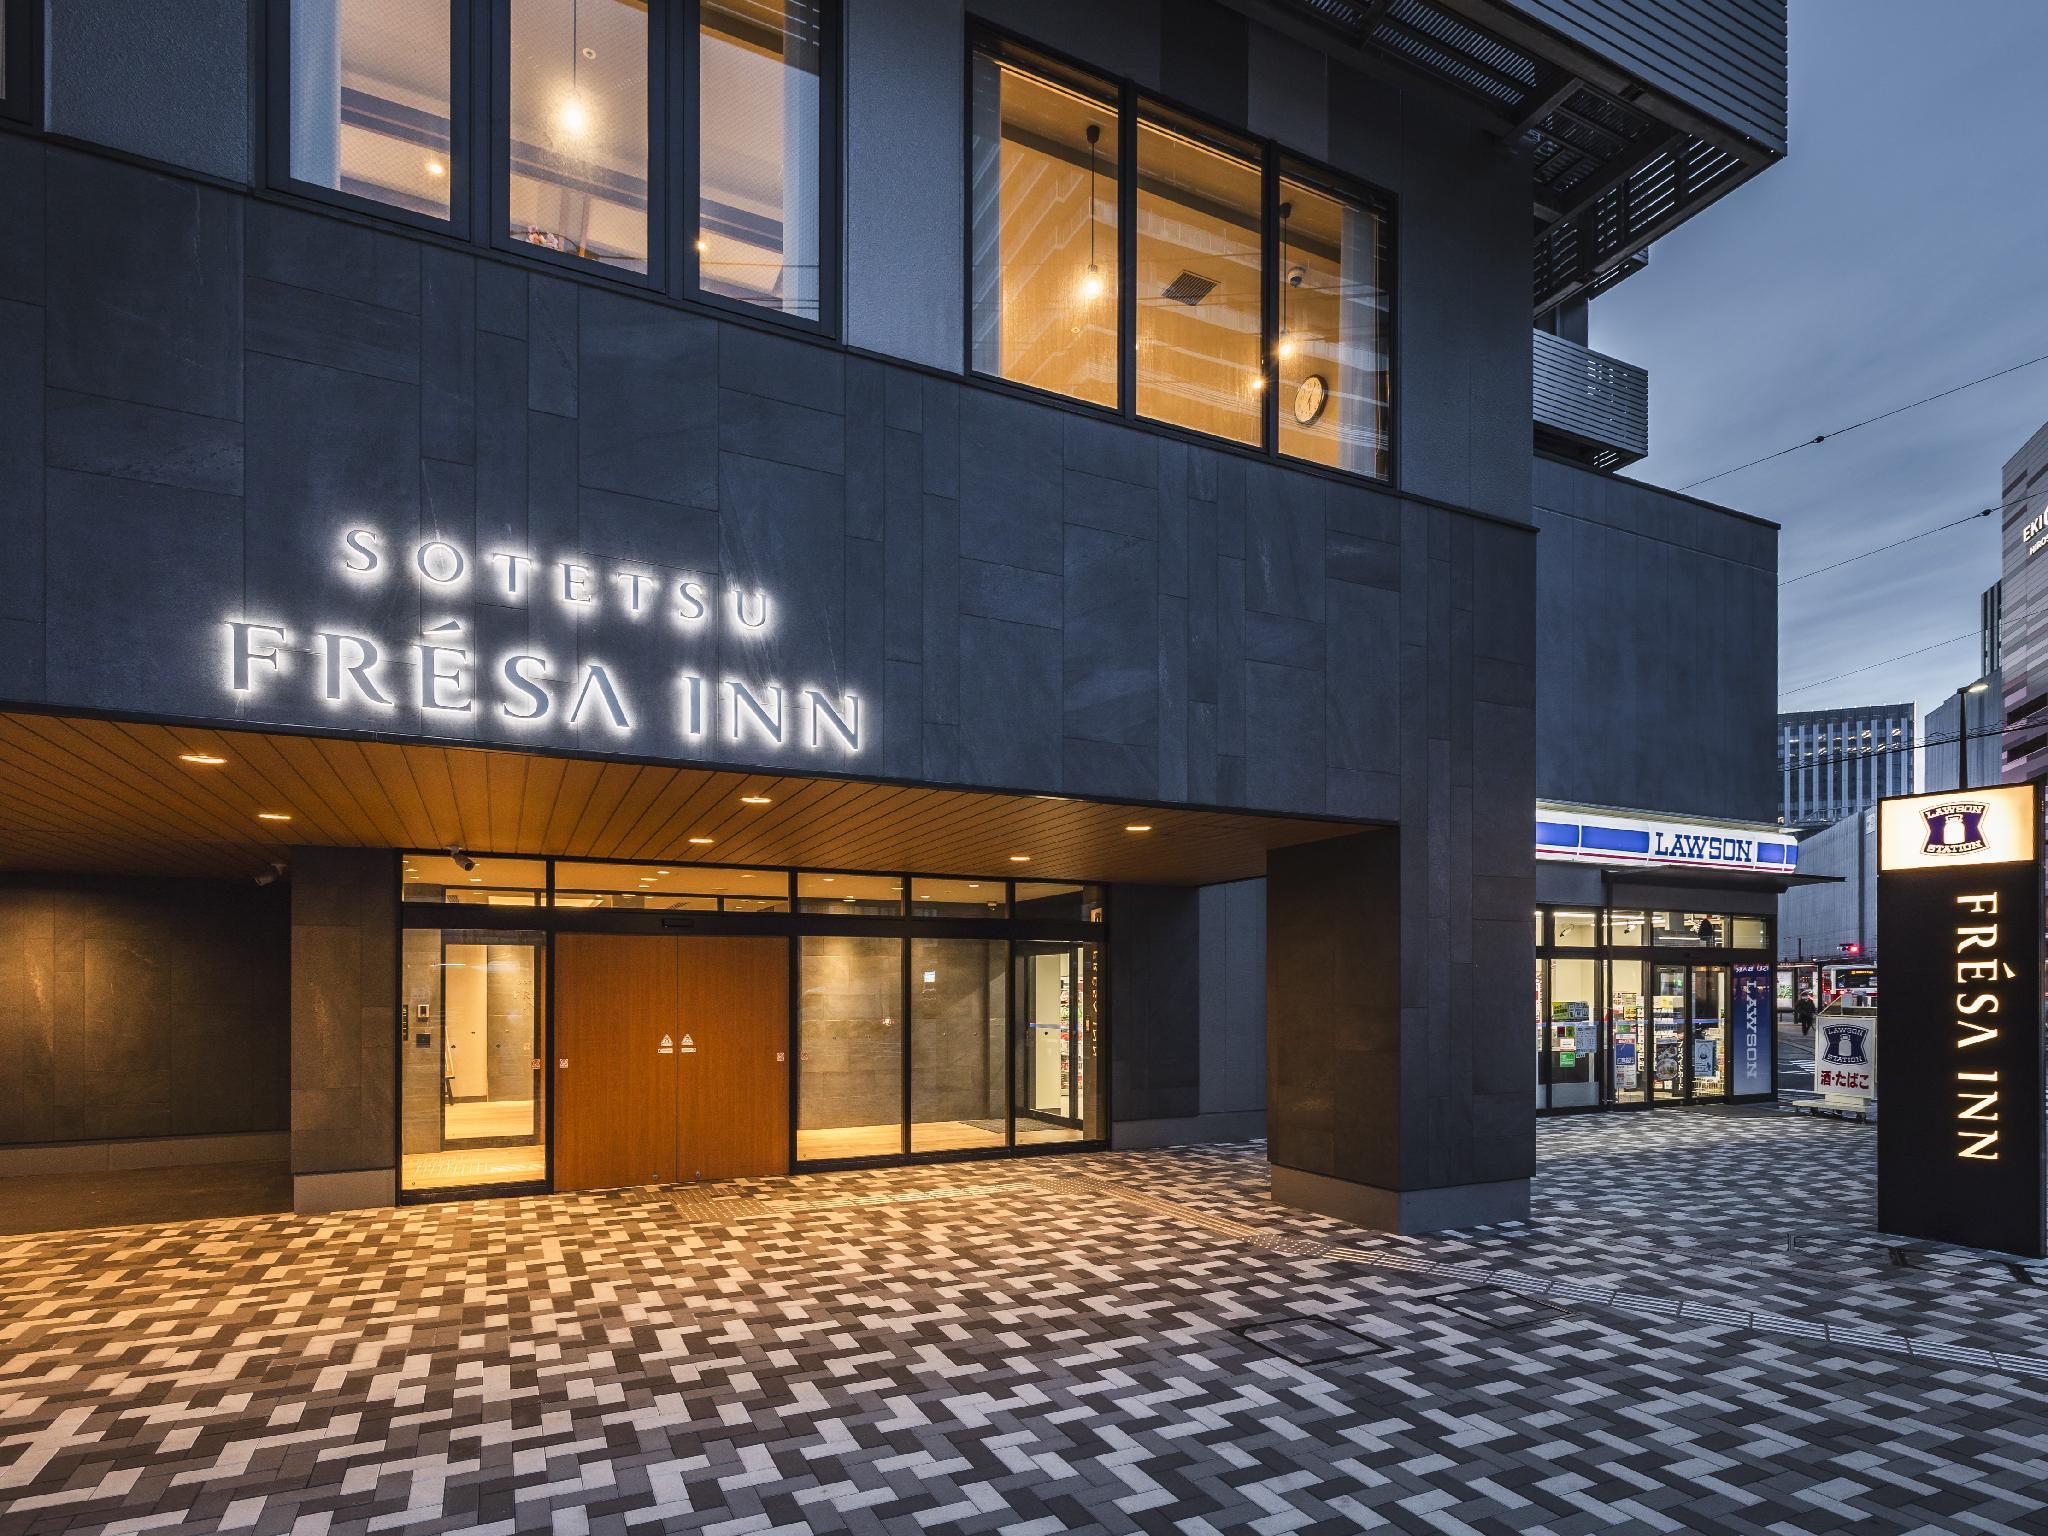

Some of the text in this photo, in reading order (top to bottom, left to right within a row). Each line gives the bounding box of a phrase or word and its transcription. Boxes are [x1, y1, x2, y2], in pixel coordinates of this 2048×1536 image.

[345, 527, 770, 629] SOTETSU
[681, 675, 861, 752] INN
[1924, 804, 1984, 820] LAWSON
[1654, 831, 1753, 863] LAWSON
[1926, 839, 1984, 854] STATION
[1746, 980, 1758, 1080] LAWSON
[1827, 1026, 1865, 1037] LAWSON
[1826, 1053, 1864, 1064] STATION
[1956, 1071, 1999, 1161] INN
